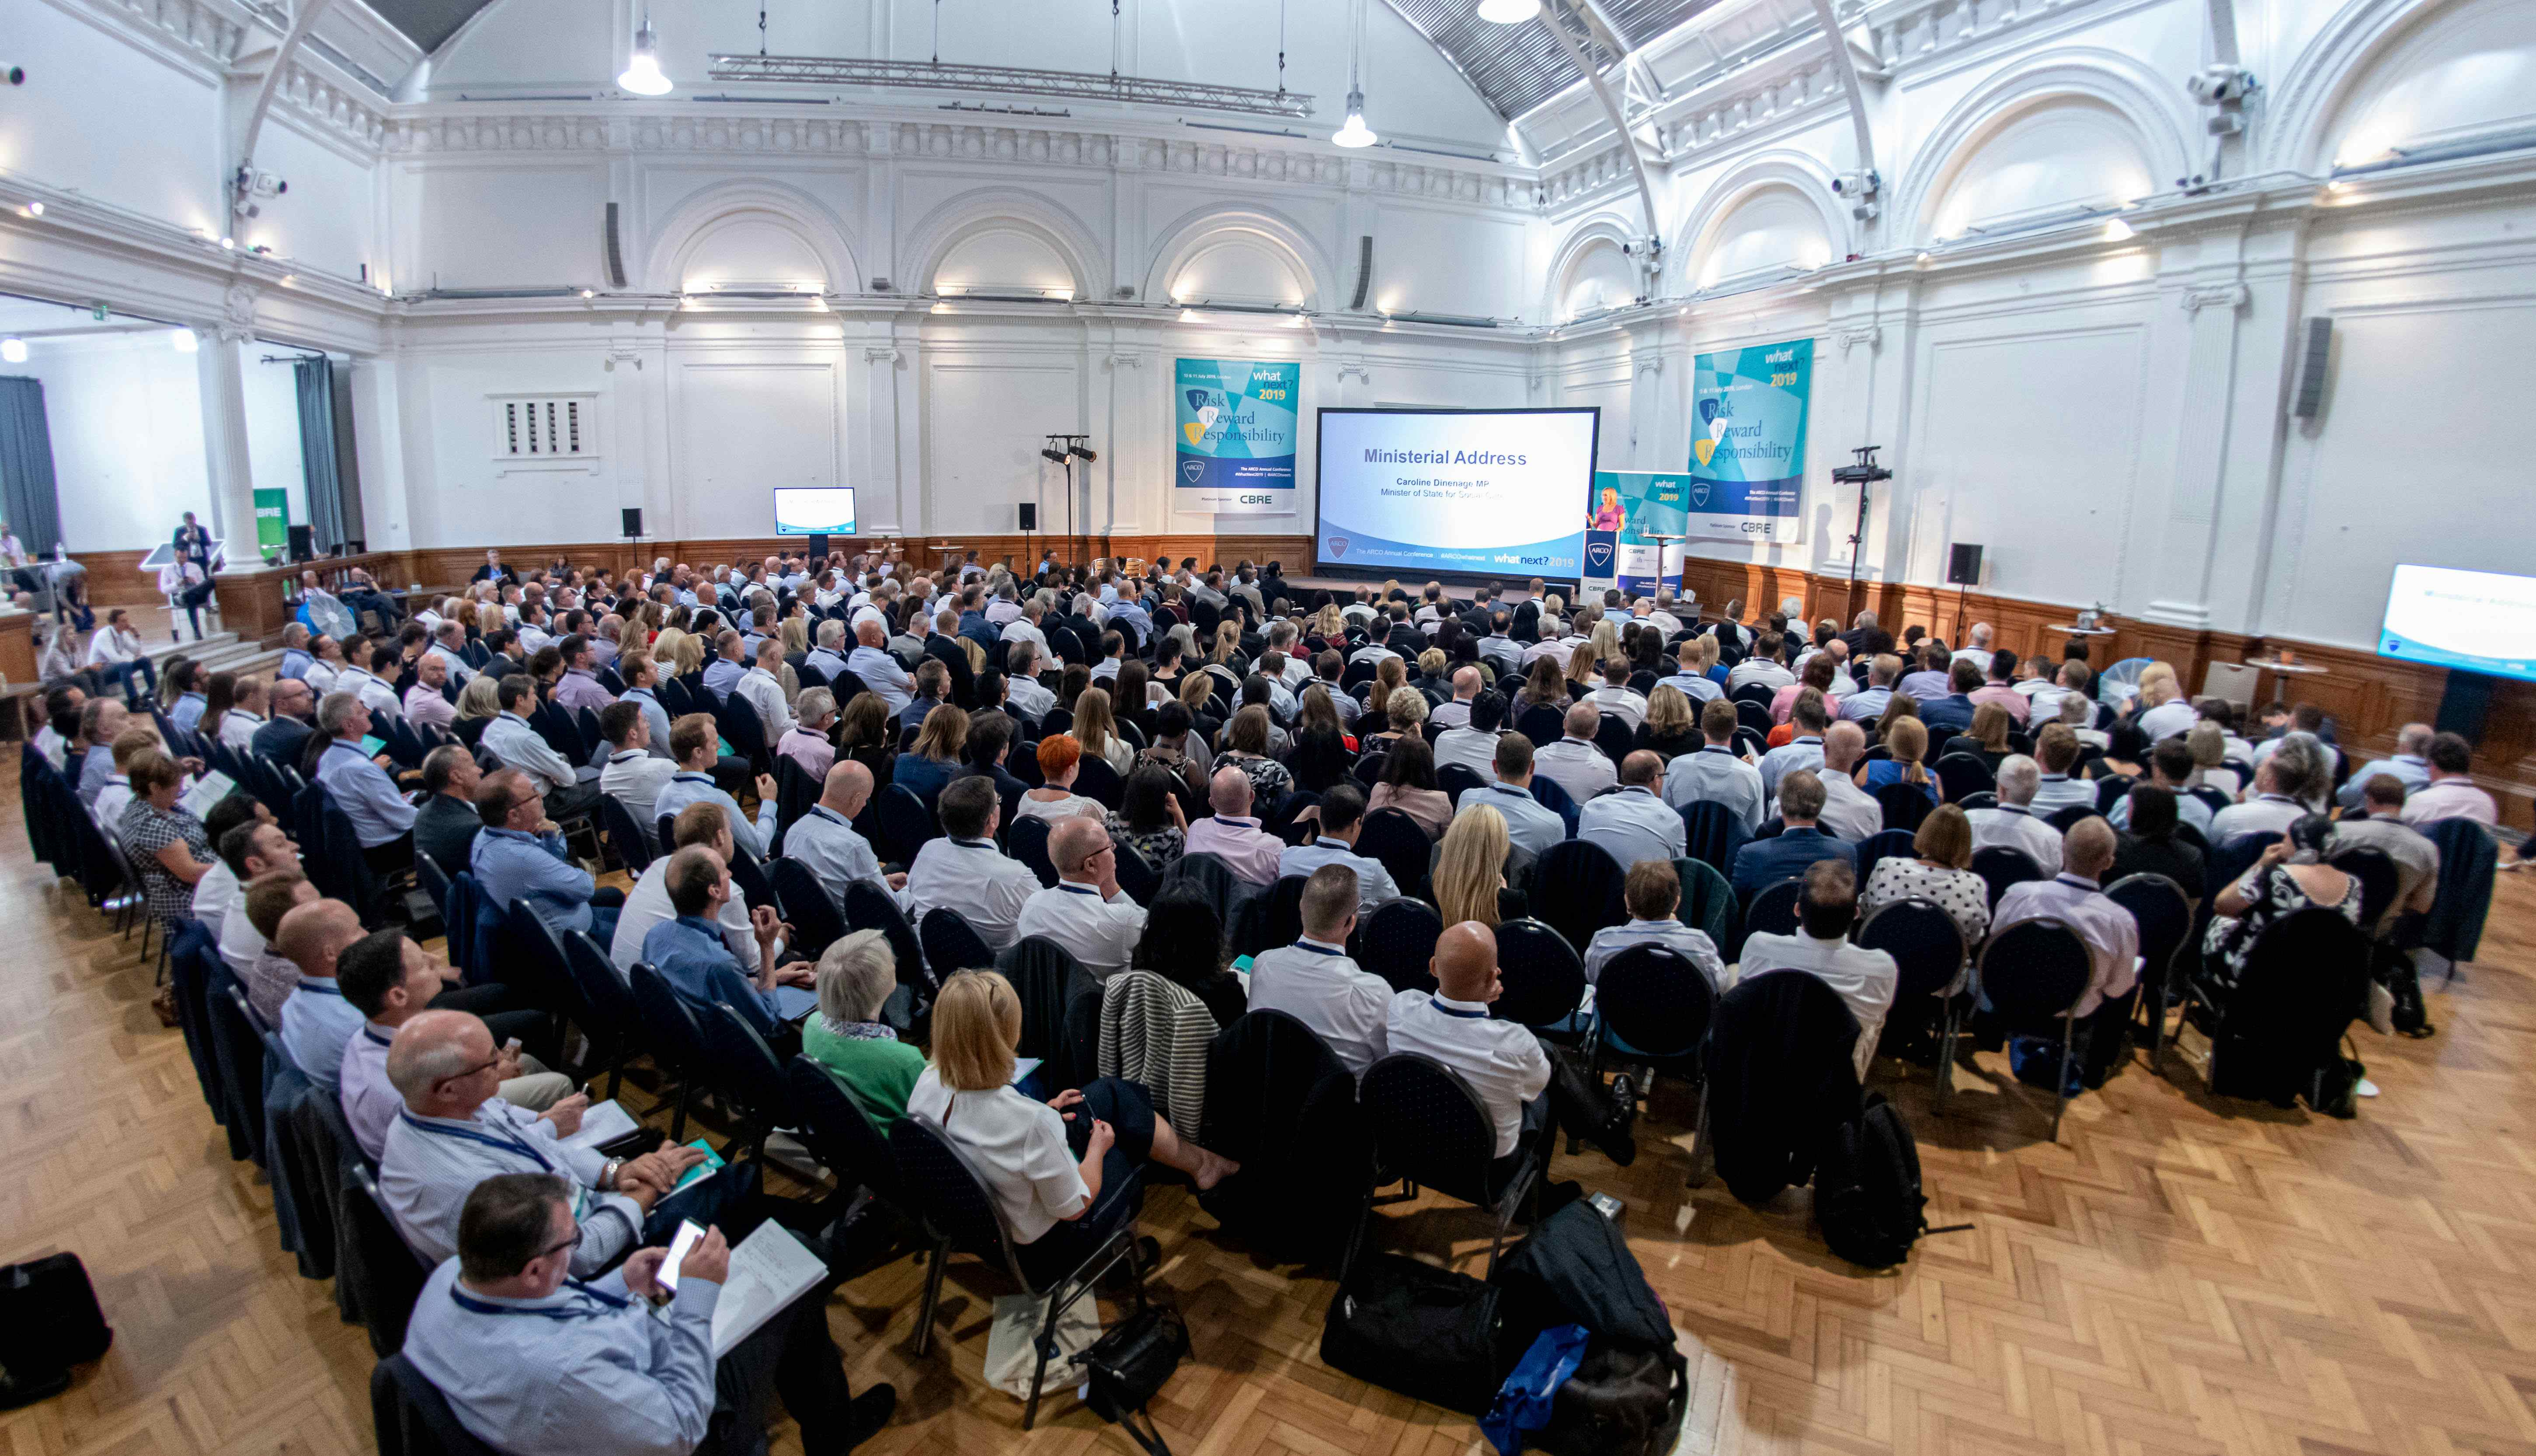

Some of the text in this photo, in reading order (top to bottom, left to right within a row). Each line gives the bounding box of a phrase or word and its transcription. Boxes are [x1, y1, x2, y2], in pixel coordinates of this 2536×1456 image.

[1765, 349, 1793, 364] what
[1774, 357, 1805, 372] next?
[1253, 370, 1281, 381] what
[1771, 372, 1797, 387] 2019
[1264, 379, 1294, 389] next?
[1195, 393, 1225, 407] Risk
[1259, 389, 1286, 400] 2019
[1708, 401, 1734, 418] Risk
[1207, 411, 1254, 424] Reward
[1193, 427, 1284, 445] Responsibility
[1716, 420, 1761, 438] Reward
[1365, 448, 1527, 465] Ministerial Address
[1705, 441, 1792, 462] Responsibility
[1397, 478, 1431, 486] Caroline
[1434, 479, 1473, 489] Dinenage
[1240, 495, 1272, 504] CBRE
[257, 507, 282, 518] BRE
[1625, 516, 1645, 524] ward
[1741, 522, 1771, 534] CBRE
[1494, 553, 1574, 567] what next? 2019
